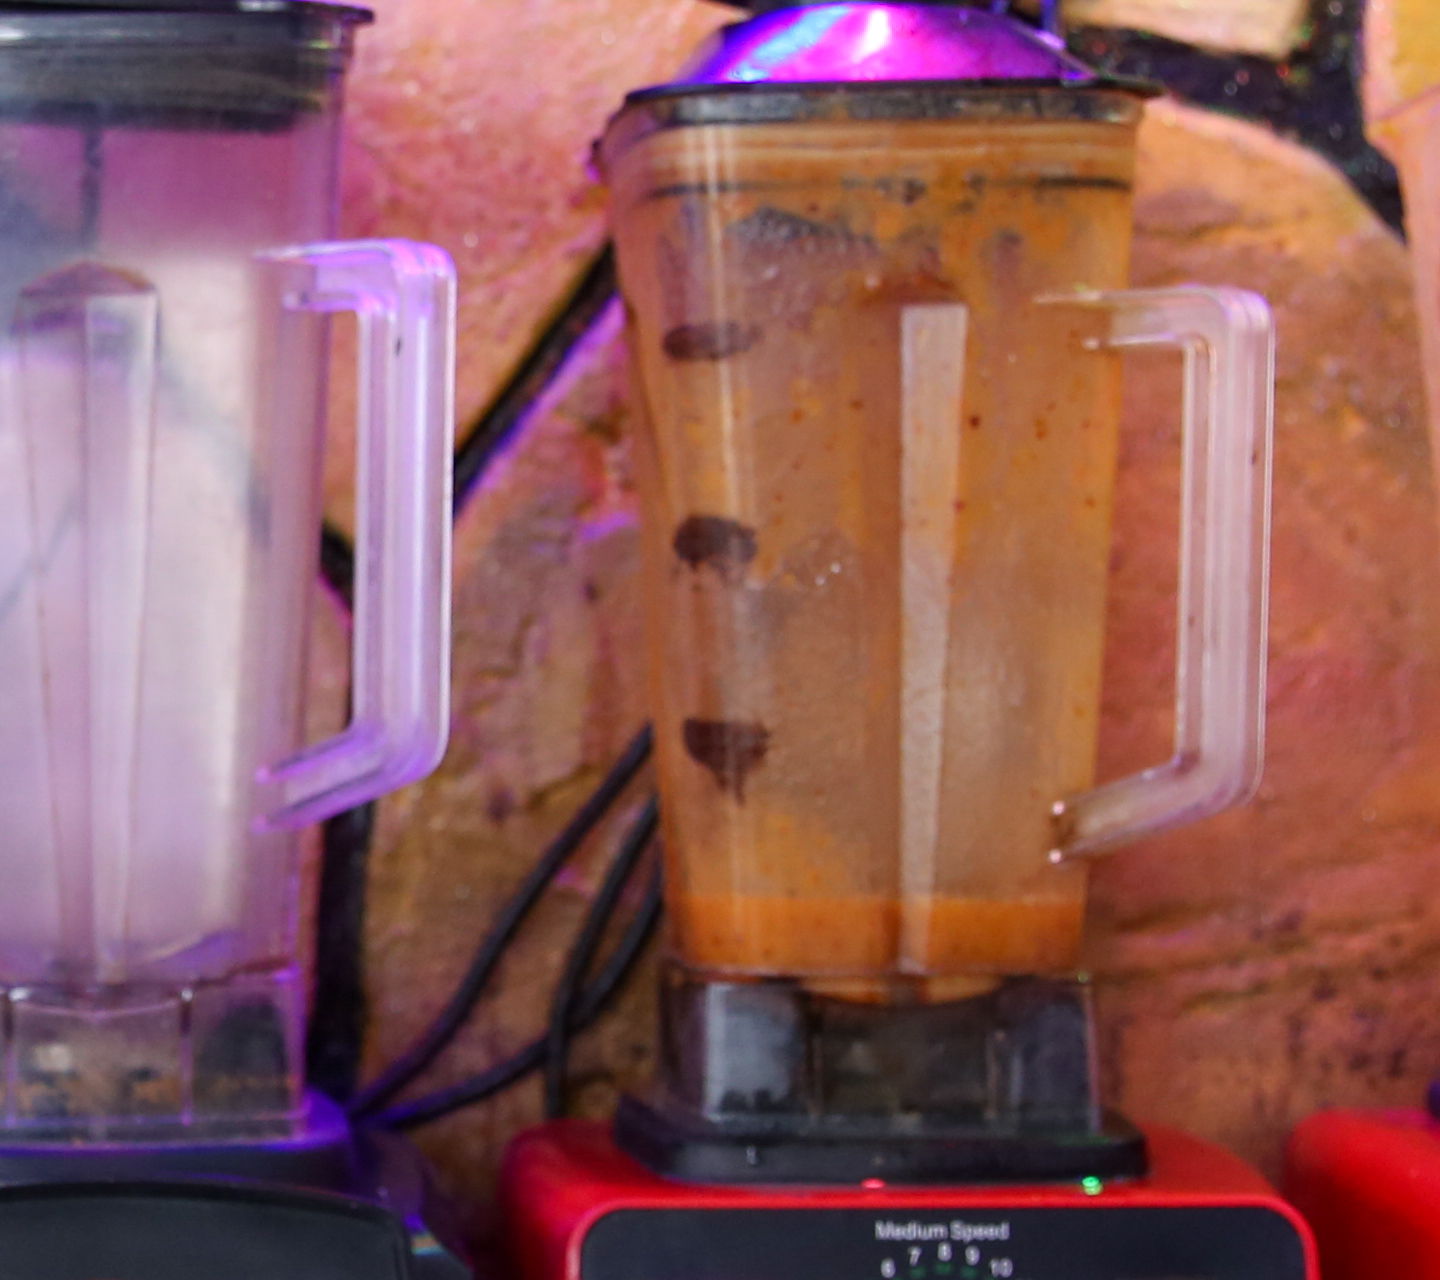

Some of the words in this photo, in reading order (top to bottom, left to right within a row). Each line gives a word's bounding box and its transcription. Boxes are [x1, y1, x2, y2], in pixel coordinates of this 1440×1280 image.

[875, 1220, 948, 1240] Medium
[950, 1219, 1010, 1242] Speed
[880, 1257, 895, 1278] 6
[907, 1245, 921, 1266] 7
[937, 1242, 952, 1262] 8
[965, 1245, 980, 1265] 9
[989, 1257, 1013, 1277] 10
